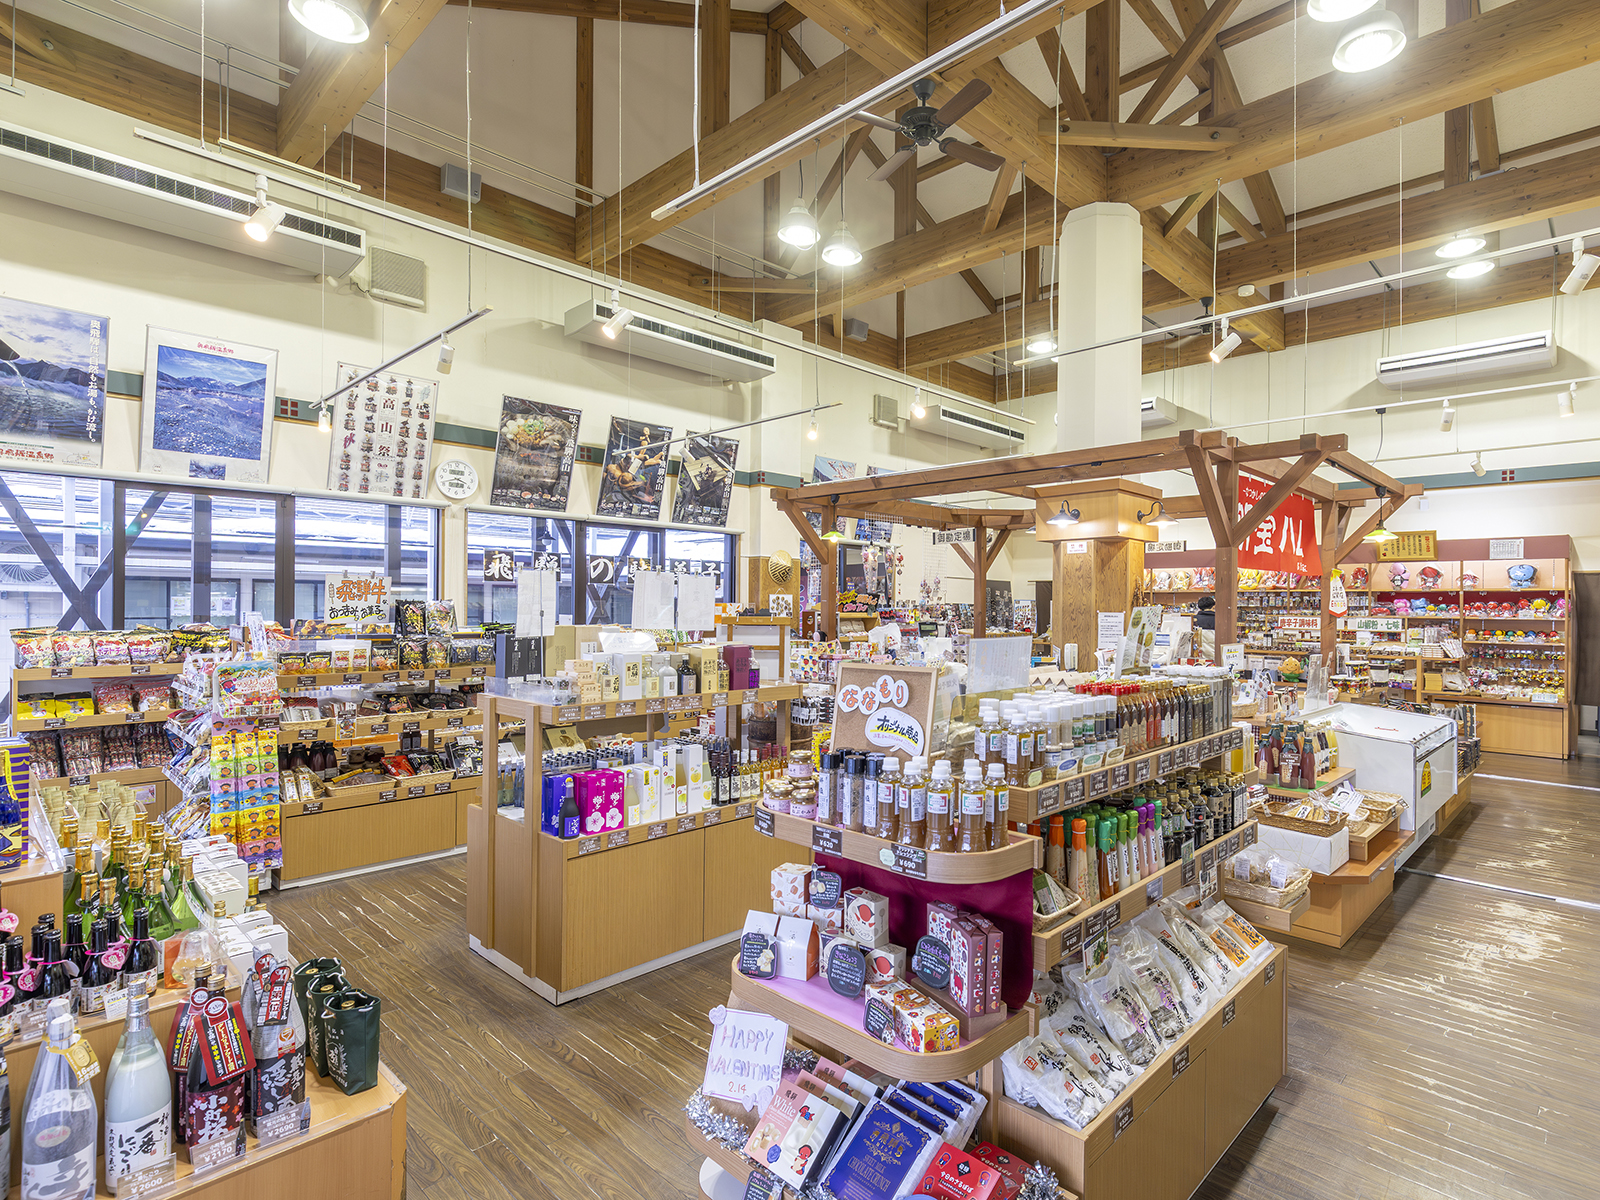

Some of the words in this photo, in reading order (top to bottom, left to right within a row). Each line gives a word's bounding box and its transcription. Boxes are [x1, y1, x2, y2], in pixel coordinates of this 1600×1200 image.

[378, 397, 396, 457] 高山祭
[336, 579, 387, 604] 飛騨牛
[1280, 618, 1318, 629] 唐辛子調味料
[842, 679, 904, 710] ななもり
[876, 715, 919, 745] オリジナル商品
[898, 859, 916, 869] ¥690
[722, 1024, 775, 1055] HAPPY
[708, 1054, 780, 1083] VALENTINE
[728, 1081, 747, 1094] 2.14
[773, 1094, 797, 1117] White
[197, 1095, 229, 1145] 小町桜
[267, 1122, 295, 1137] ¥2690
[133, 1117, 163, 1155] 一番
[204, 1146, 233, 1163] ¥2170
[130, 1177, 163, 1194] ¥2600
[940, 1171, 975, 1194] 今日のさるぼぼ
